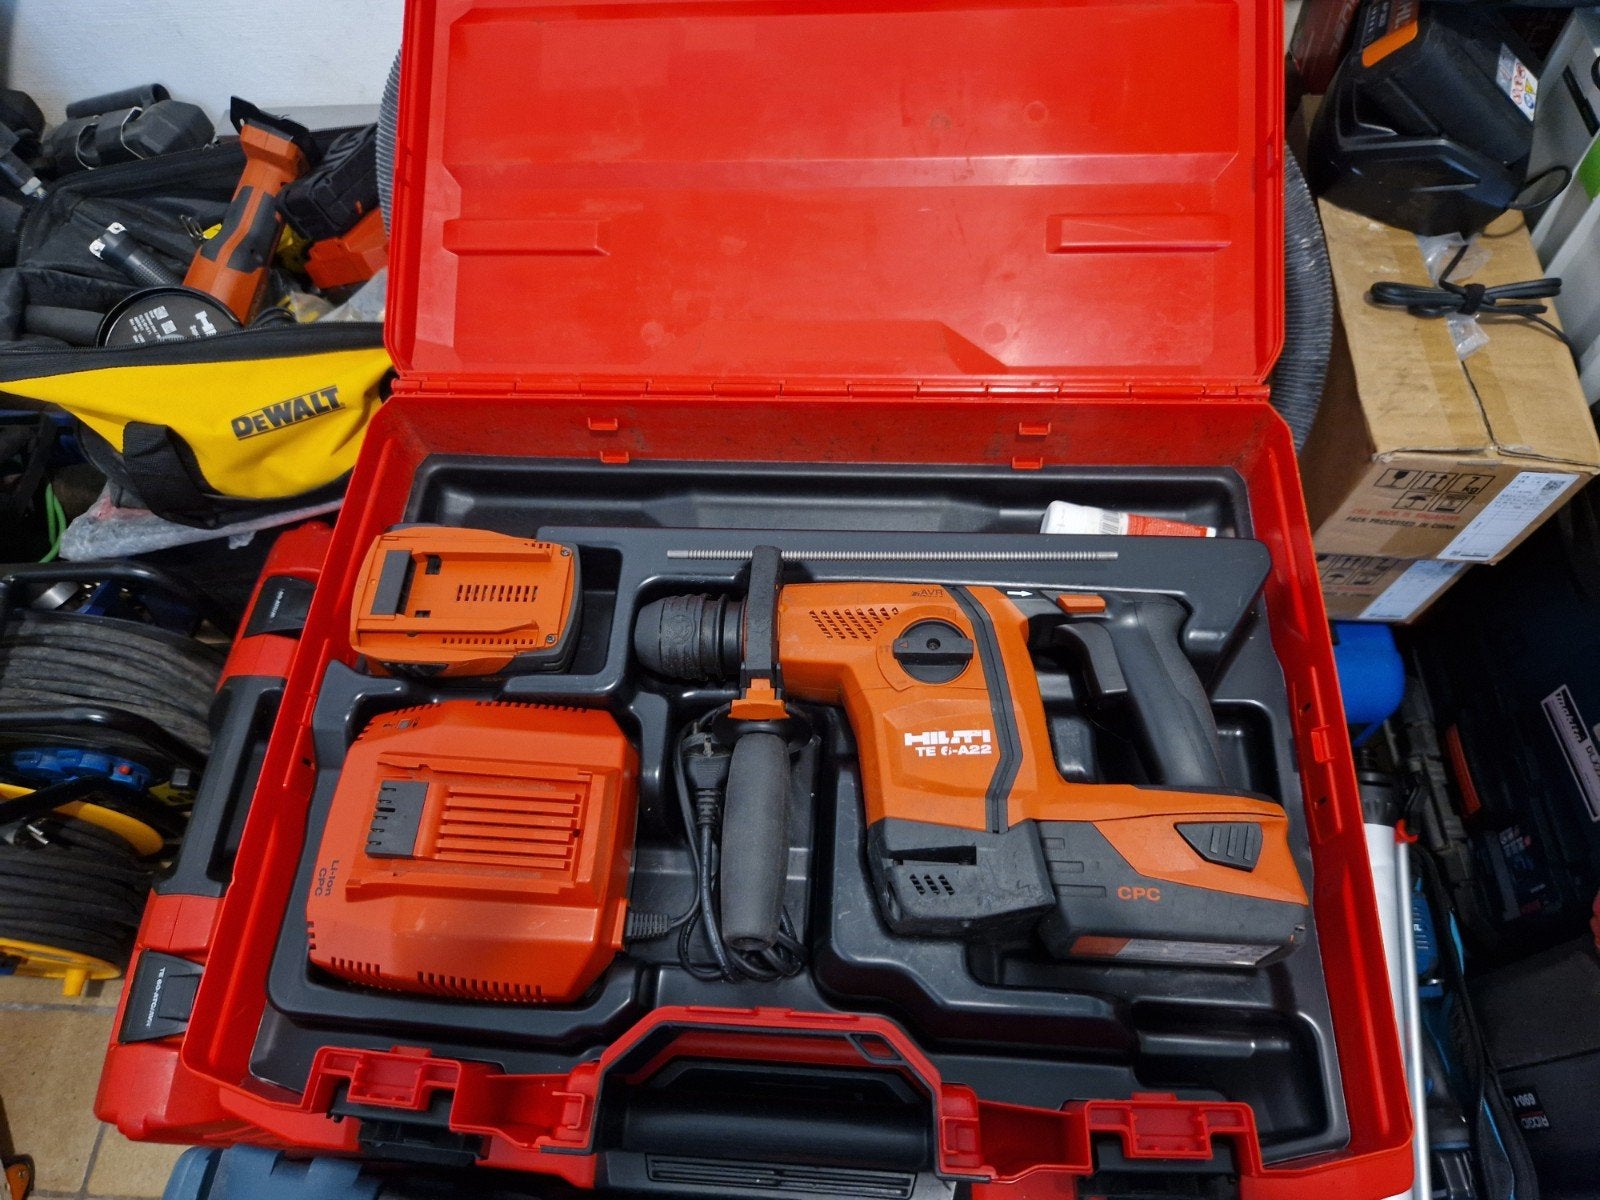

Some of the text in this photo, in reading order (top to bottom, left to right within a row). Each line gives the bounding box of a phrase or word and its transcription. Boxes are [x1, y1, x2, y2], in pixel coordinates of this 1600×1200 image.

[231, 387, 341, 438] DEWALT
[904, 729, 991, 746] HILTI
[915, 746, 936, 757] TE
[314, 867, 327, 896] CPC
[1117, 886, 1161, 902] CPC
